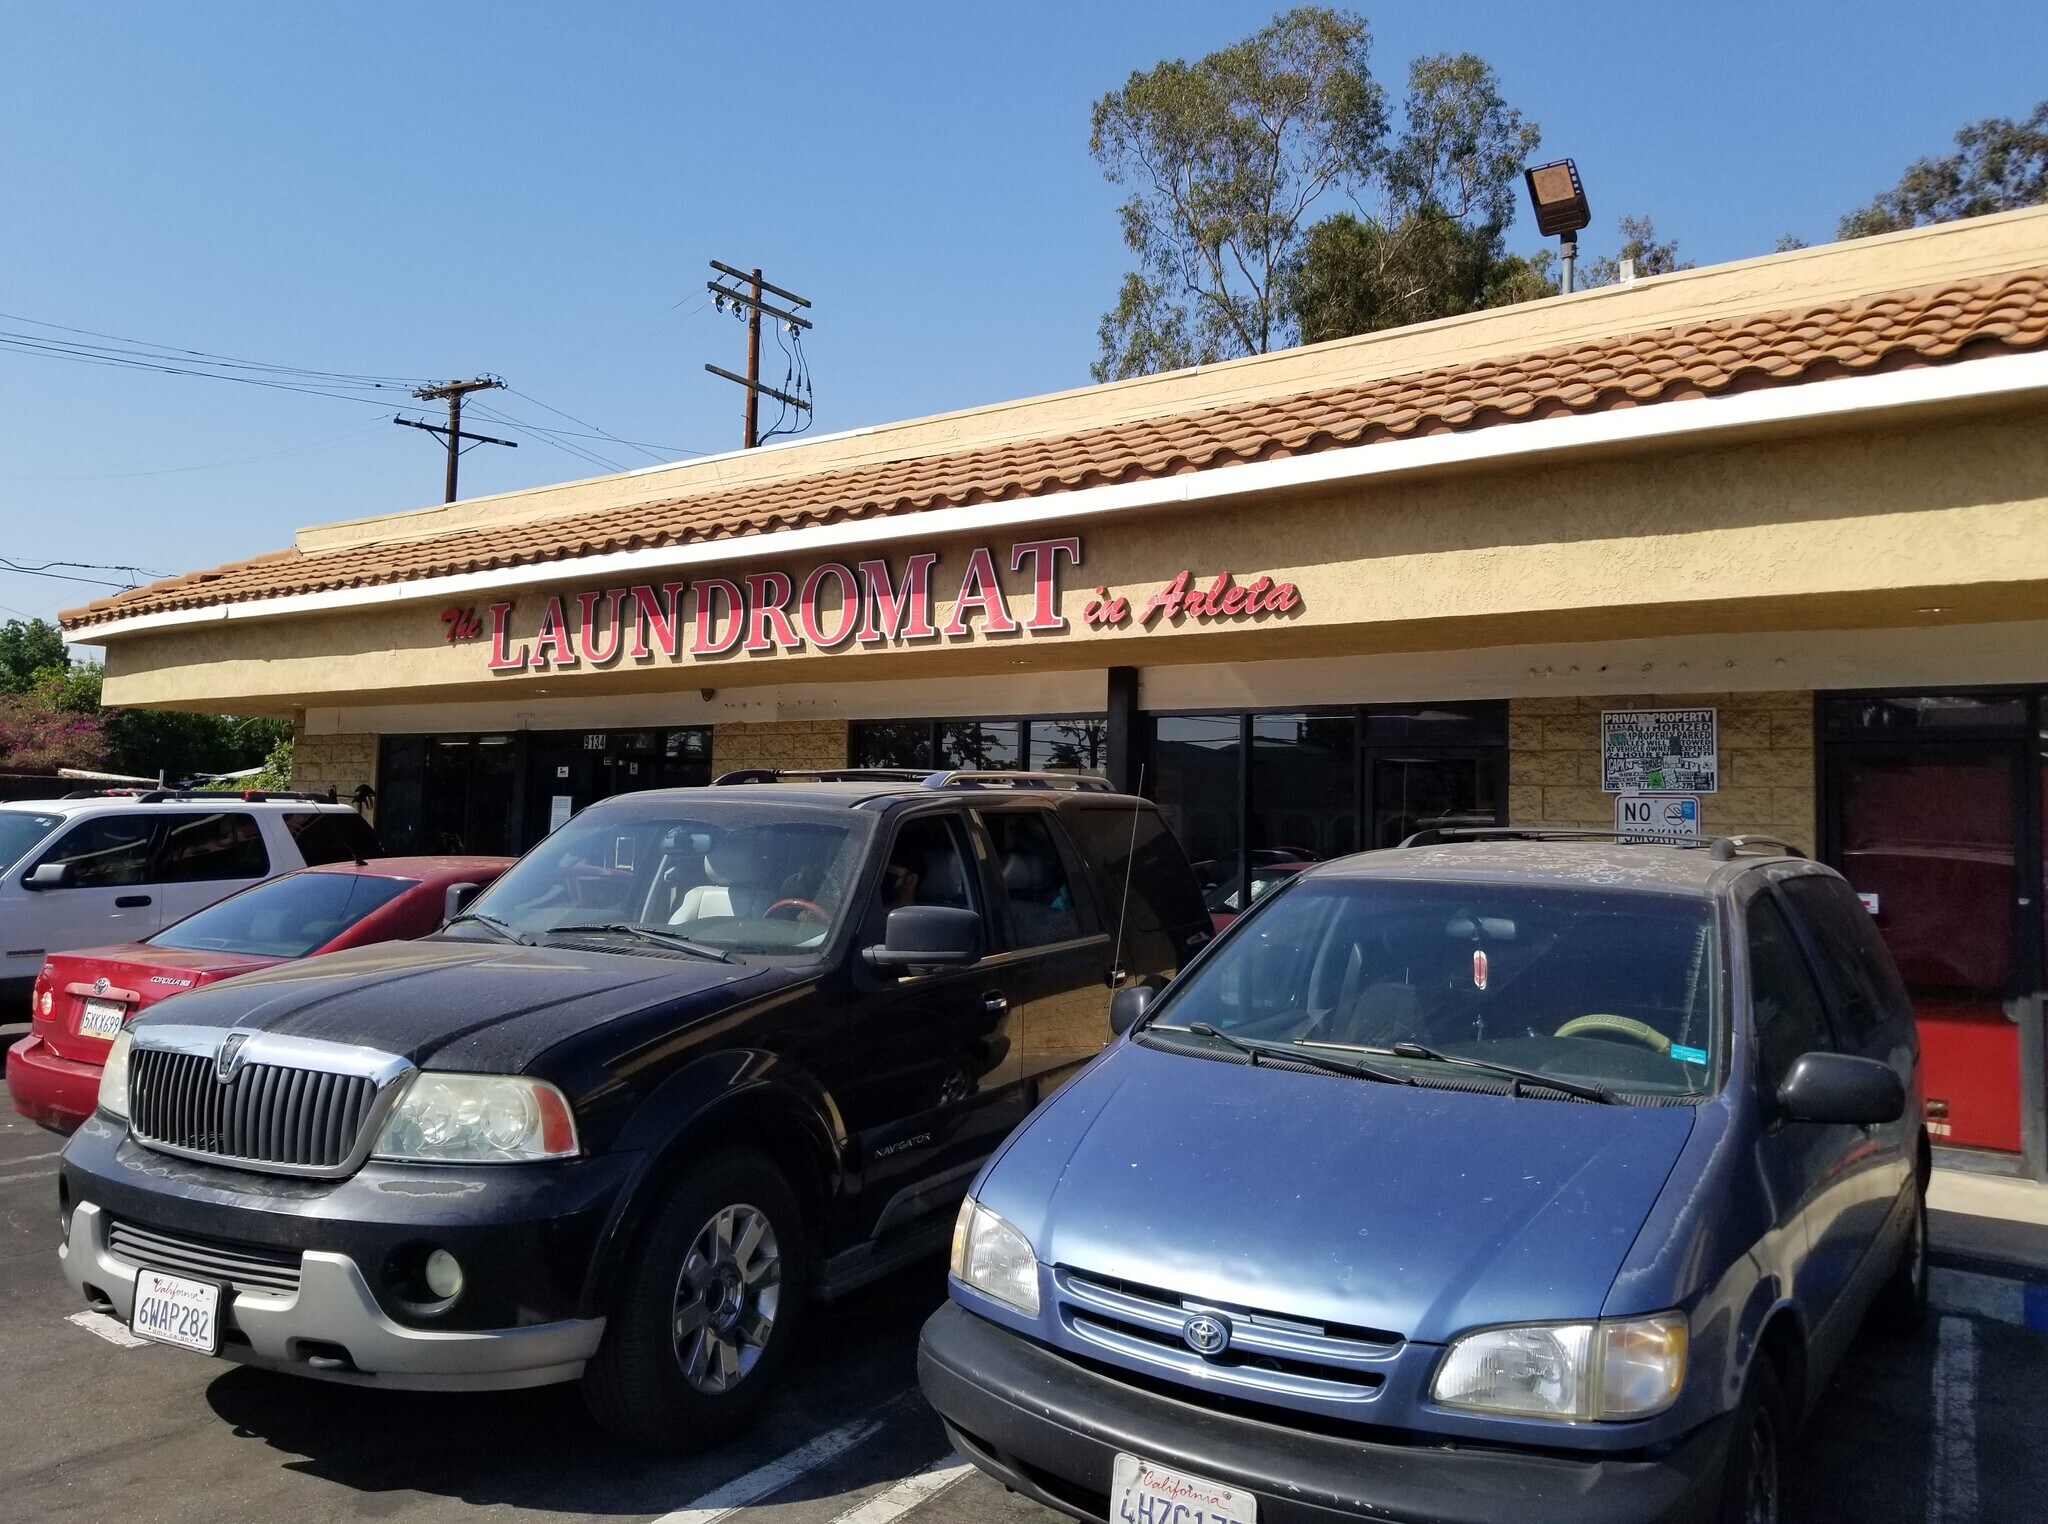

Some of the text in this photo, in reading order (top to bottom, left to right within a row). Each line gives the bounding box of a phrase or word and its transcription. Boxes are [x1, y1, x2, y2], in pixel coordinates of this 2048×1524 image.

[441, 537, 1300, 670] The LAUNDROMAT in Arleta
[1605, 712, 1711, 724] PRIVA PROPERTY
[584, 735, 605, 749] 9134
[1678, 731, 1711, 740] PARKED
[1625, 803, 1651, 821] NO
[875, 1132, 931, 1159] NAVIGATOR
[154, 1279, 203, 1302] California
[139, 1297, 209, 1341] 6WAP282
[1143, 1470, 1230, 1509] California
